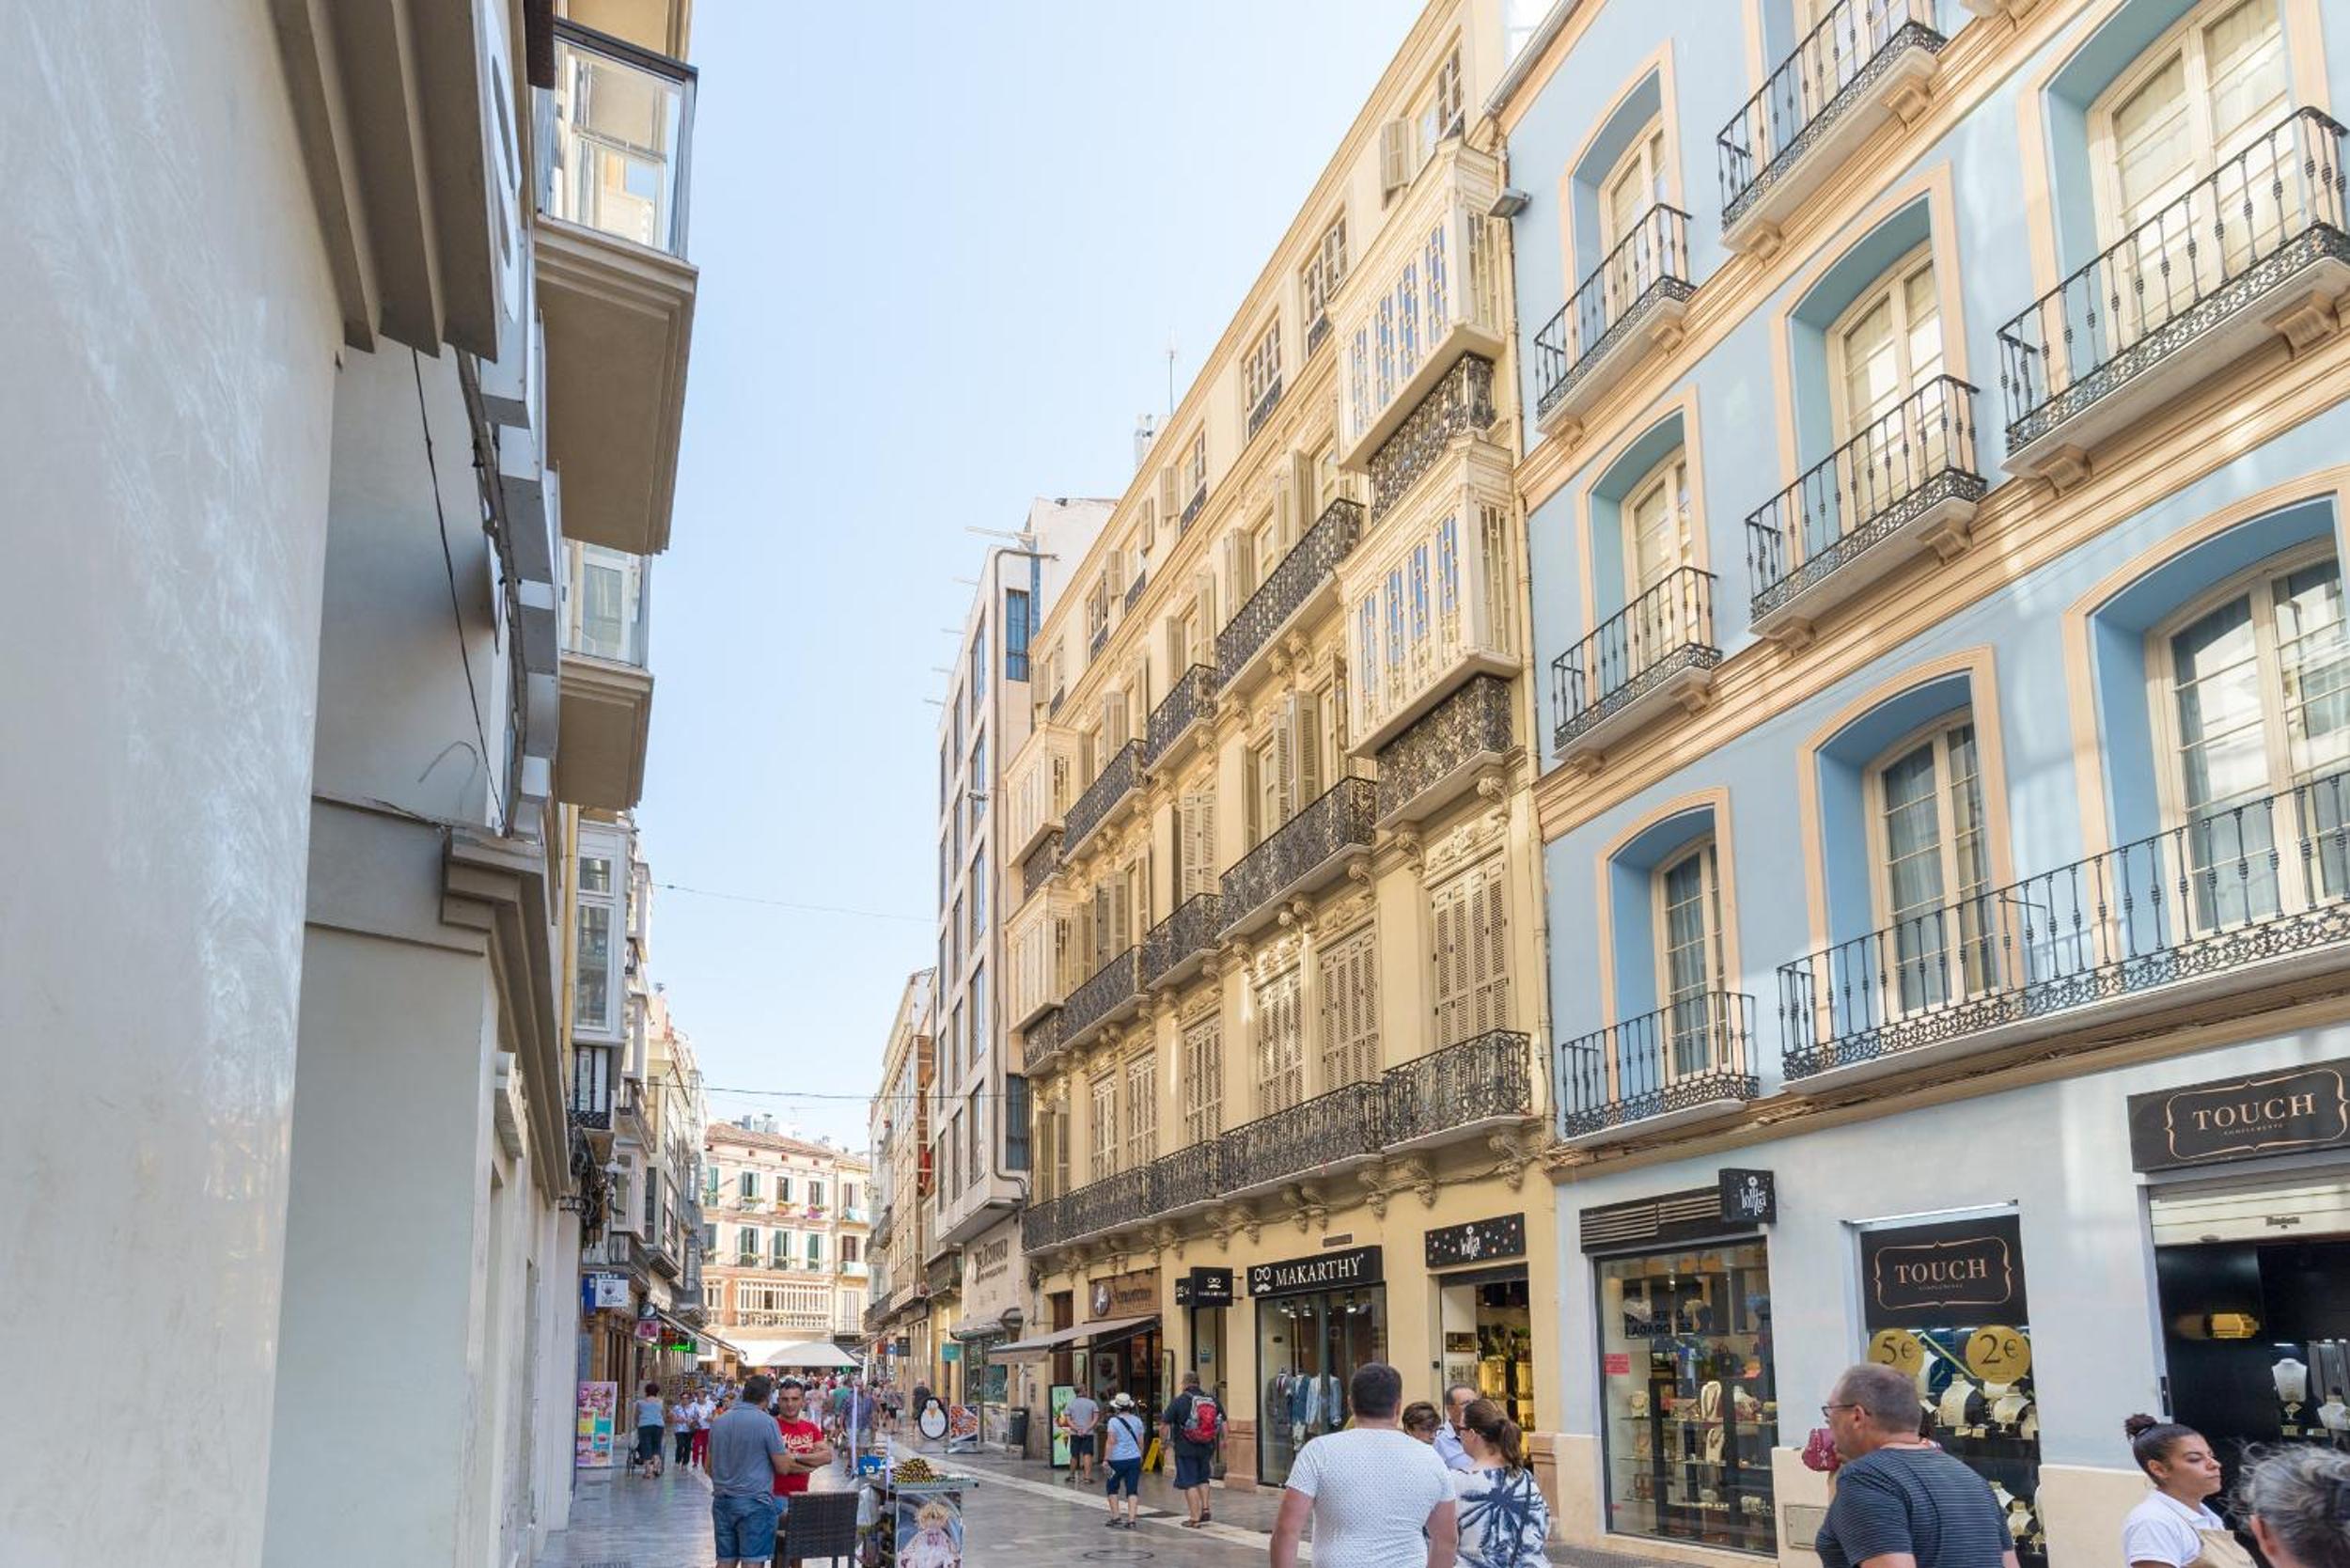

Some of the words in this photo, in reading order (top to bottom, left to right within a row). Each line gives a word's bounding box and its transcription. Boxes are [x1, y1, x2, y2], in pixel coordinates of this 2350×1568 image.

[2193, 1092, 2315, 1130] TOUCH
[1276, 1257, 1360, 1287] MAKARTHY
[1895, 1258, 1988, 1284] TOUCH
[1881, 1337, 1915, 1364] 5€
[1980, 1334, 2019, 1365] 2€
